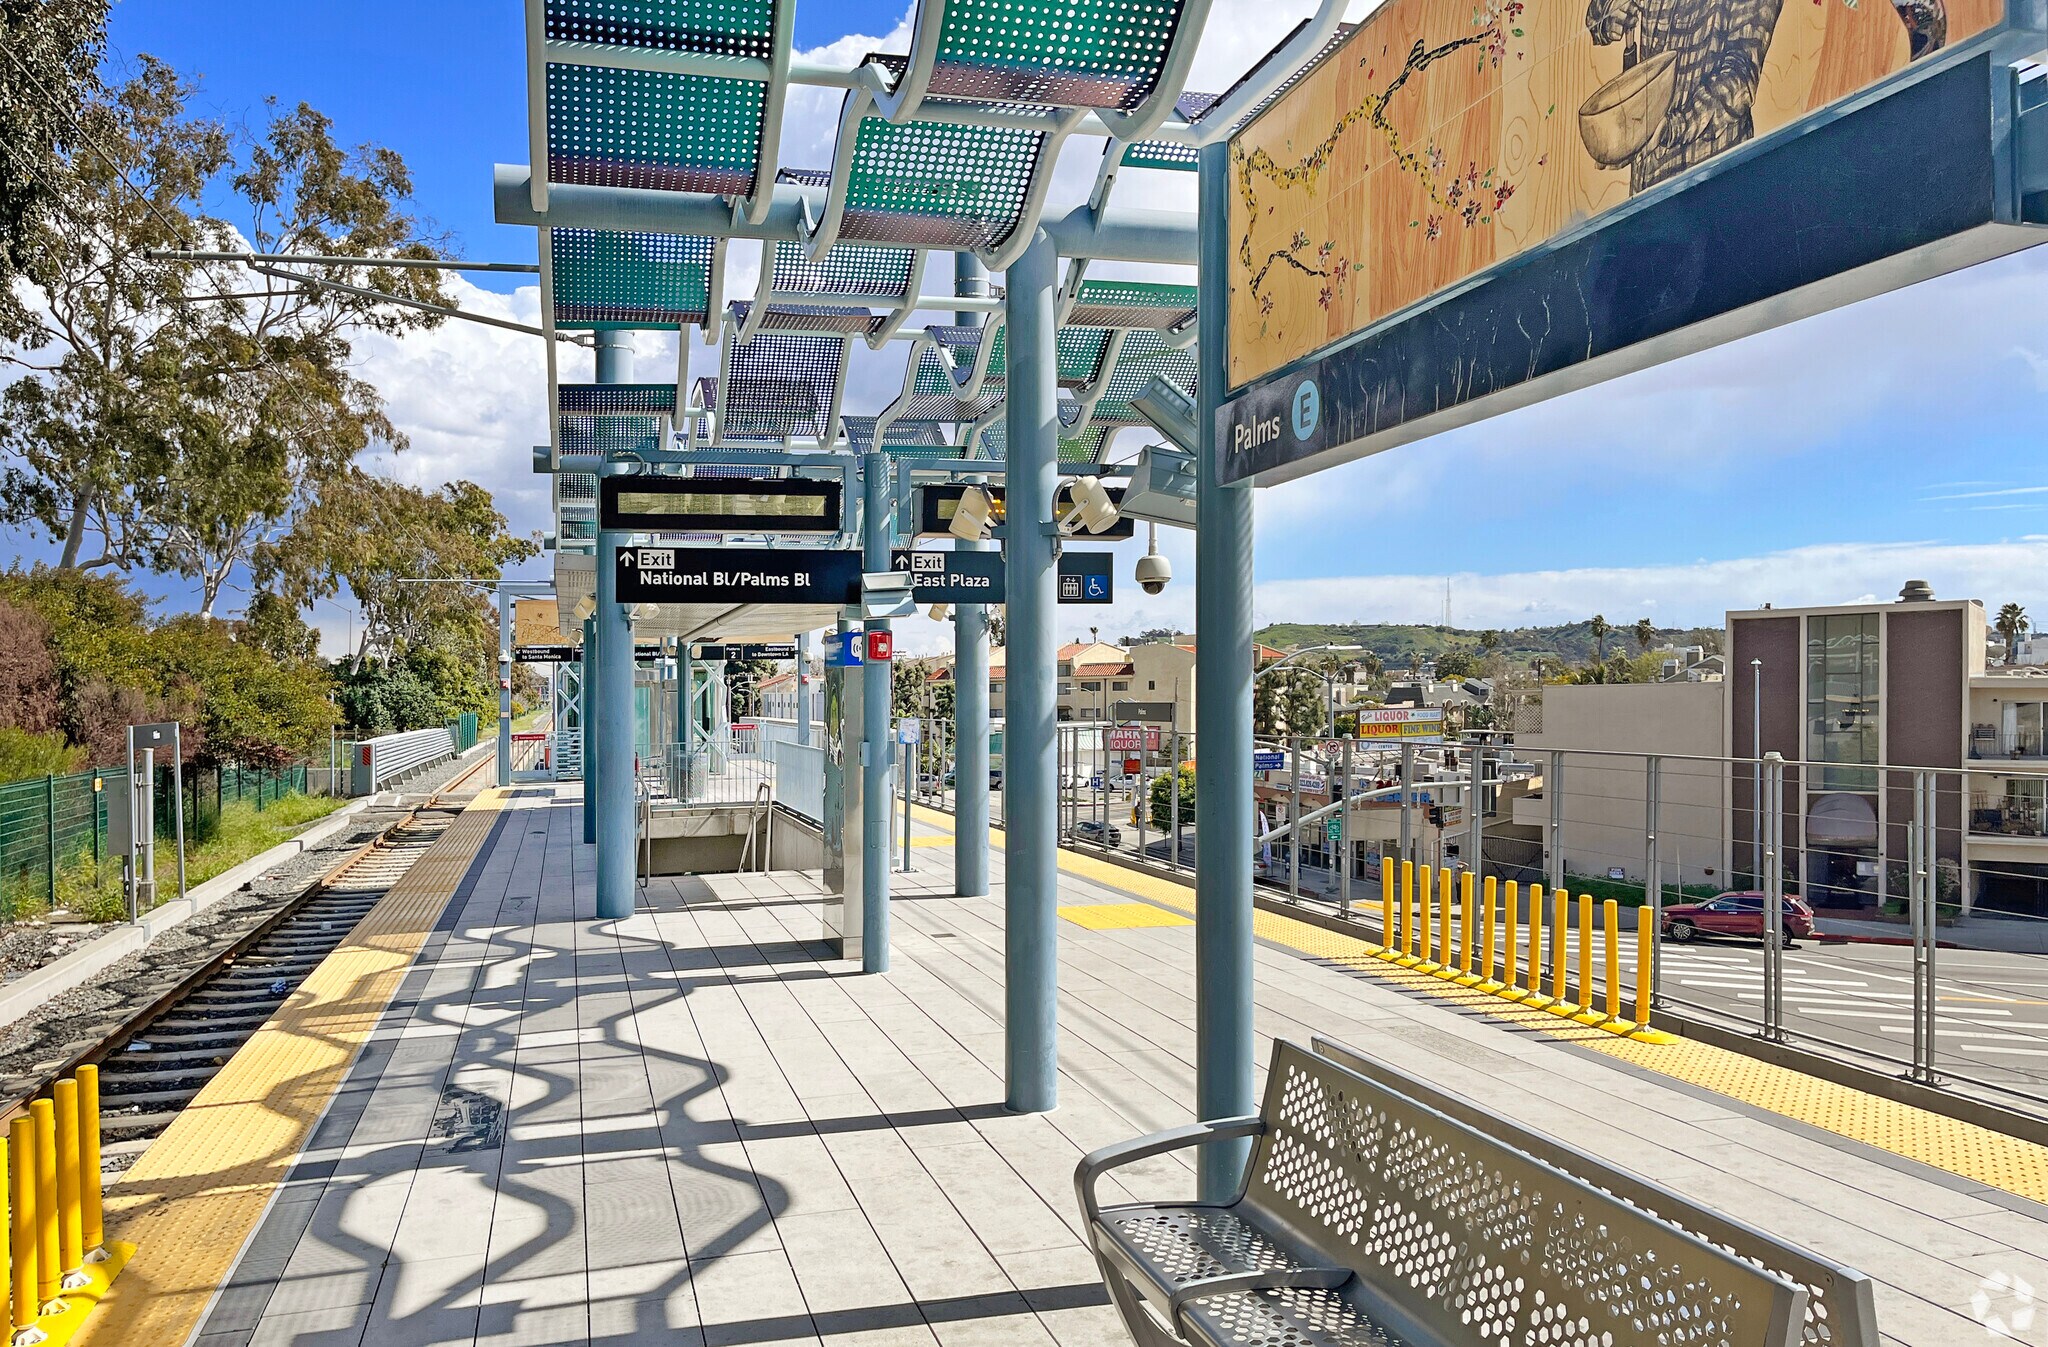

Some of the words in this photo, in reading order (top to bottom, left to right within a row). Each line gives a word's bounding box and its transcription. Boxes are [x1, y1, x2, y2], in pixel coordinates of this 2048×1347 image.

[1234, 414, 1280, 454] Palms
[1300, 391, 1312, 430] E
[640, 552, 672, 567] Exit
[914, 556, 942, 569] Exit
[640, 571, 708, 586] National
[713, 571, 789, 587] Bl/Palms
[794, 572, 811, 587] Bl
[914, 574, 946, 588] East
[950, 574, 990, 588] Plaza
[1374, 710, 1410, 722] LIQUOR
[1361, 724, 1399, 736] LIQUOR
[1403, 725, 1420, 735] FINE
[1422, 723, 1441, 733] WINE
[1110, 739, 1141, 749] IQUOR
[1092, 777, 1099, 786] H
